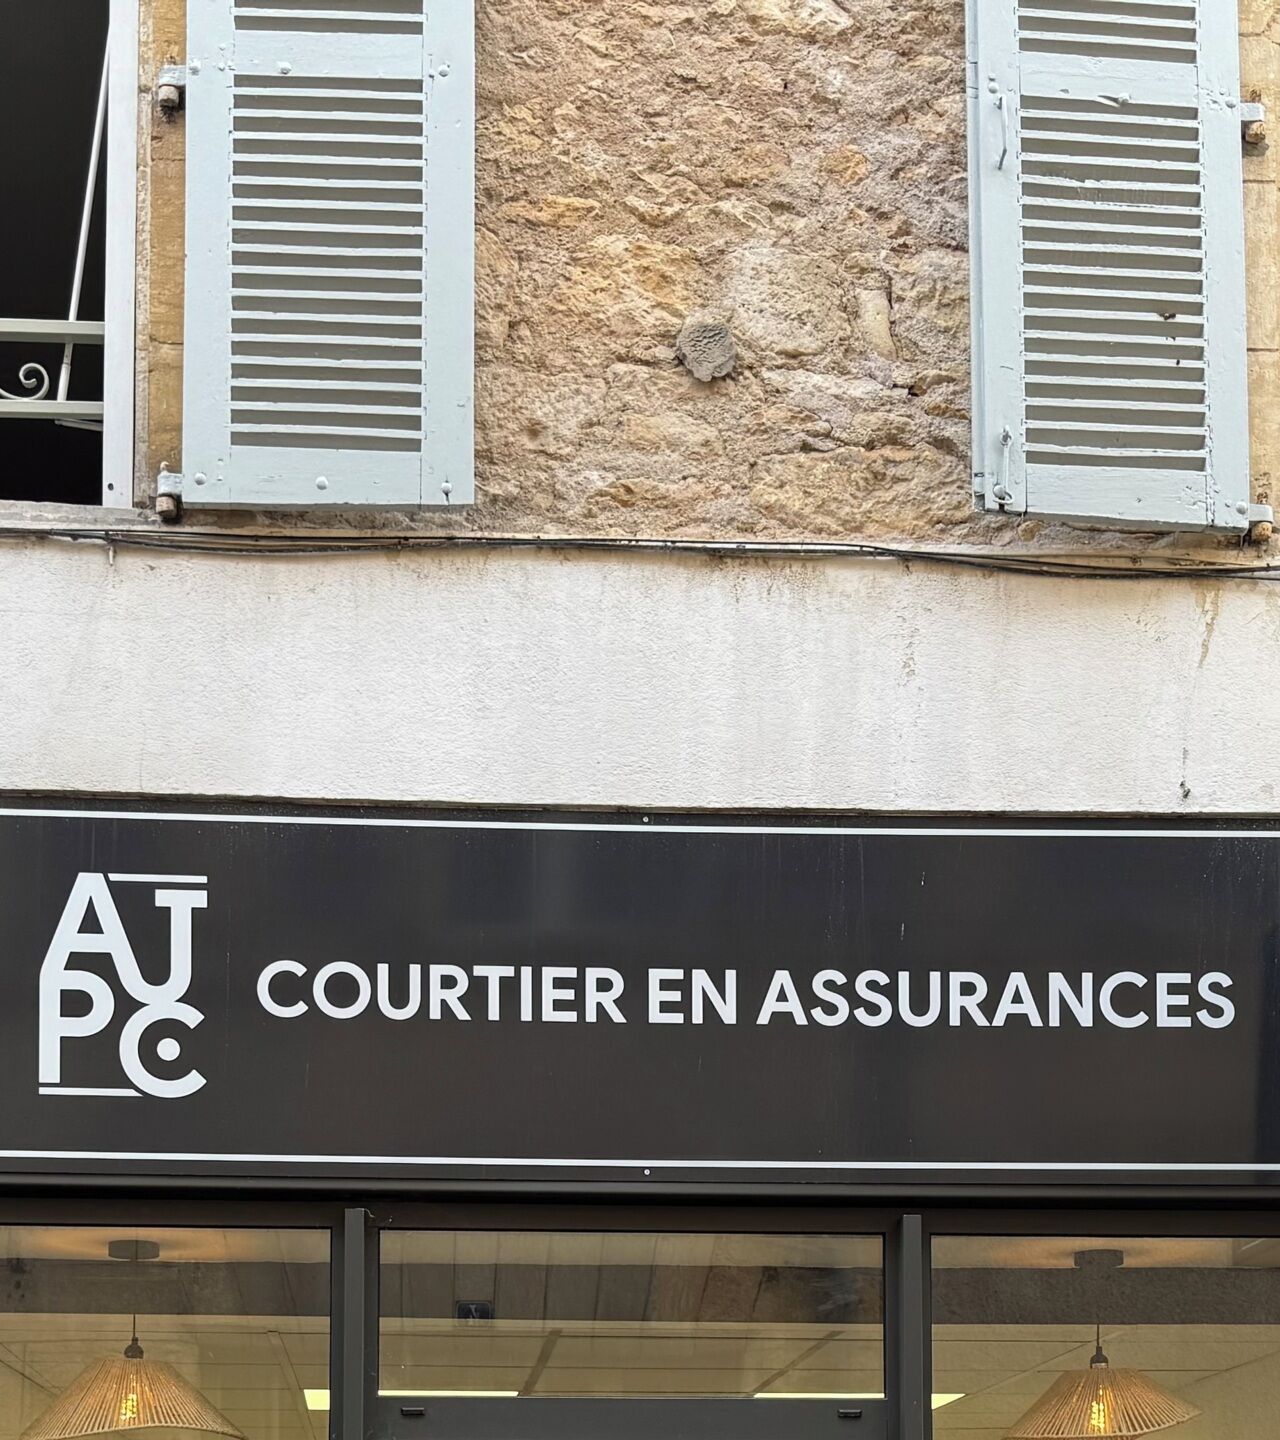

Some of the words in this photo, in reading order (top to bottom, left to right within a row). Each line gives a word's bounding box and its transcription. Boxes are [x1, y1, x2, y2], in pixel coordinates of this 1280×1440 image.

[256, 959, 626, 1024] COURTIER
[647, 967, 738, 1025] EN
[756, 969, 1236, 1029] ASSURANCES
